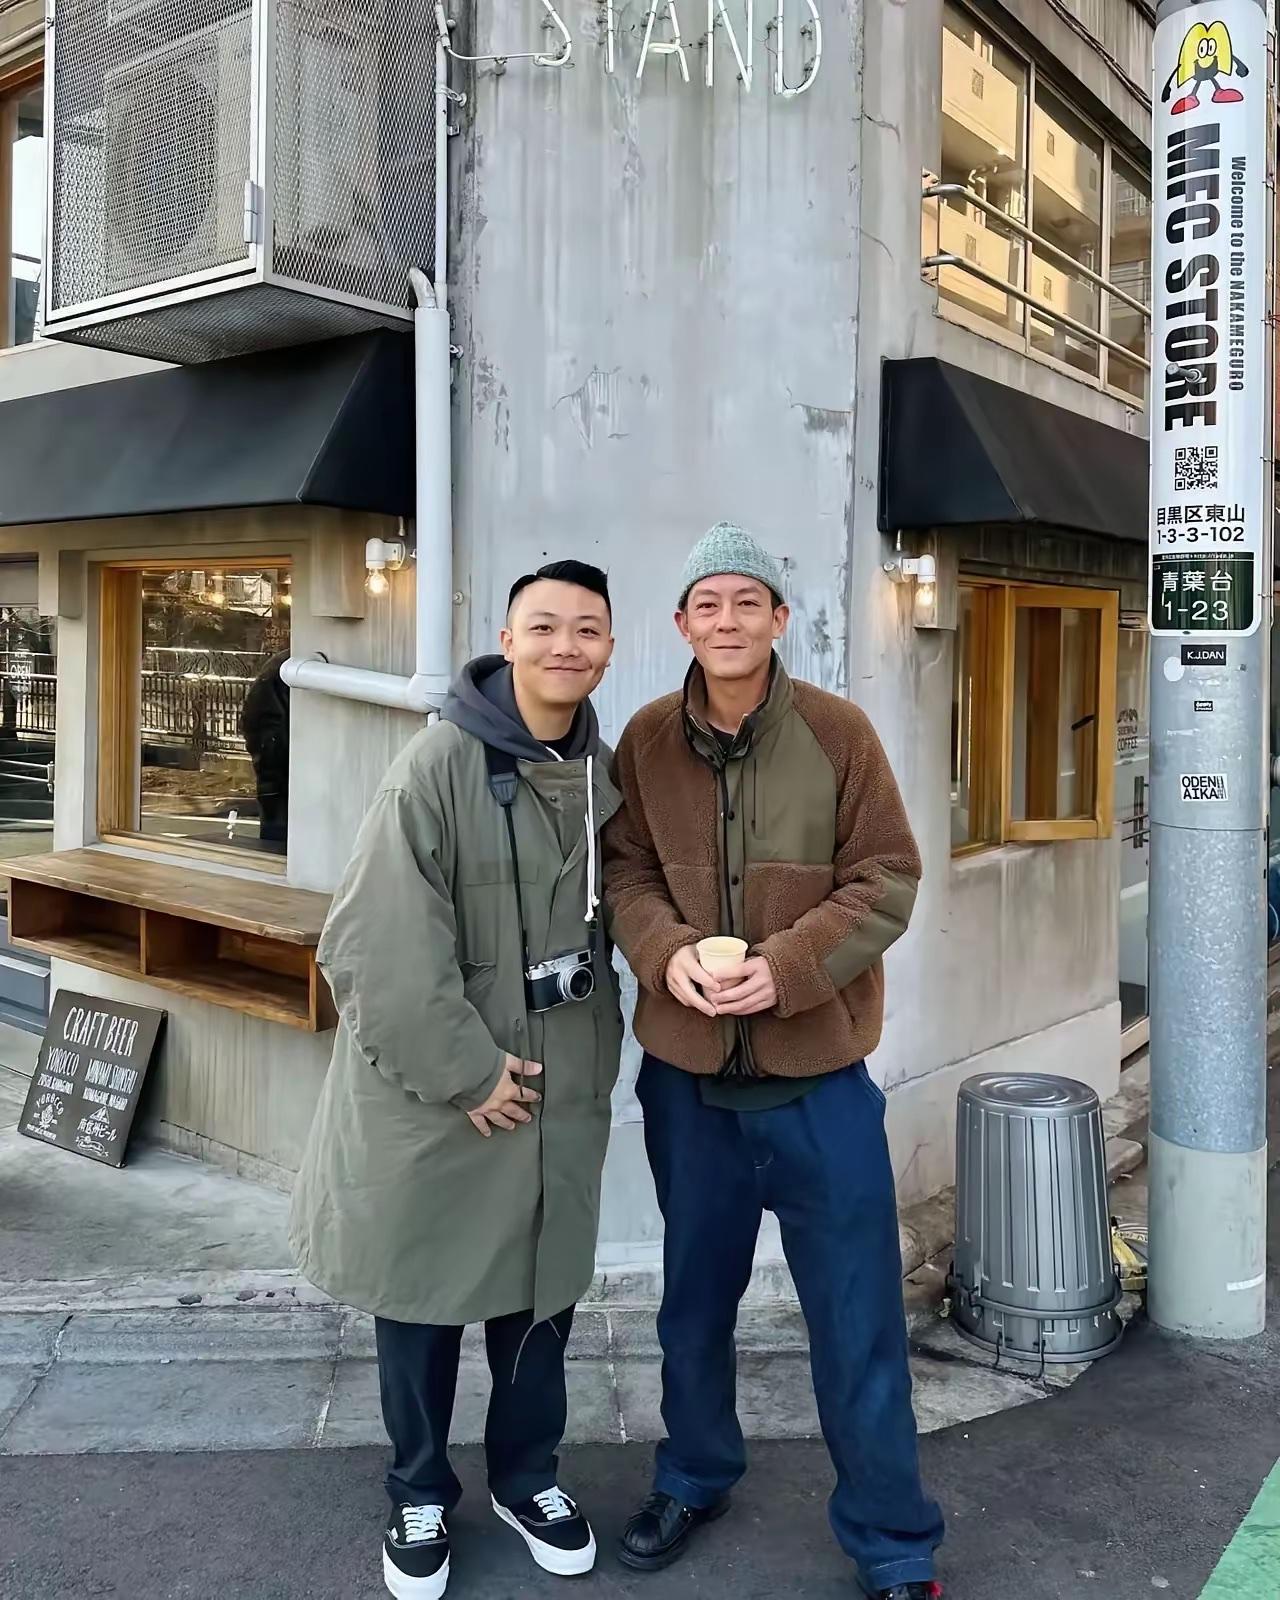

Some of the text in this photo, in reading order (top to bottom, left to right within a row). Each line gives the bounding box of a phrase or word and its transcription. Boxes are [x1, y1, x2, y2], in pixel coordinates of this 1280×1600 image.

[1165, 123, 1220, 431] MFC STORE
[1229, 156, 1246, 391] Welcome to the NAKAMEGURO
[1157, 504, 1245, 526] 目黒区東山
[1157, 527, 1245, 544] 1-3-3-102
[1162, 570, 1233, 592] 青葉台
[1164, 600, 1229, 621] 1-23
[1186, 651, 1224, 660] K.J.DAN
[10, 664, 31, 680] OPEN
[1117, 736, 1138, 752] COFFEE
[63, 1006, 139, 1058] CRAFT BEER
[45, 1046, 80, 1077] YOROCCO
[36, 1092, 64, 1116] YOROCCO
